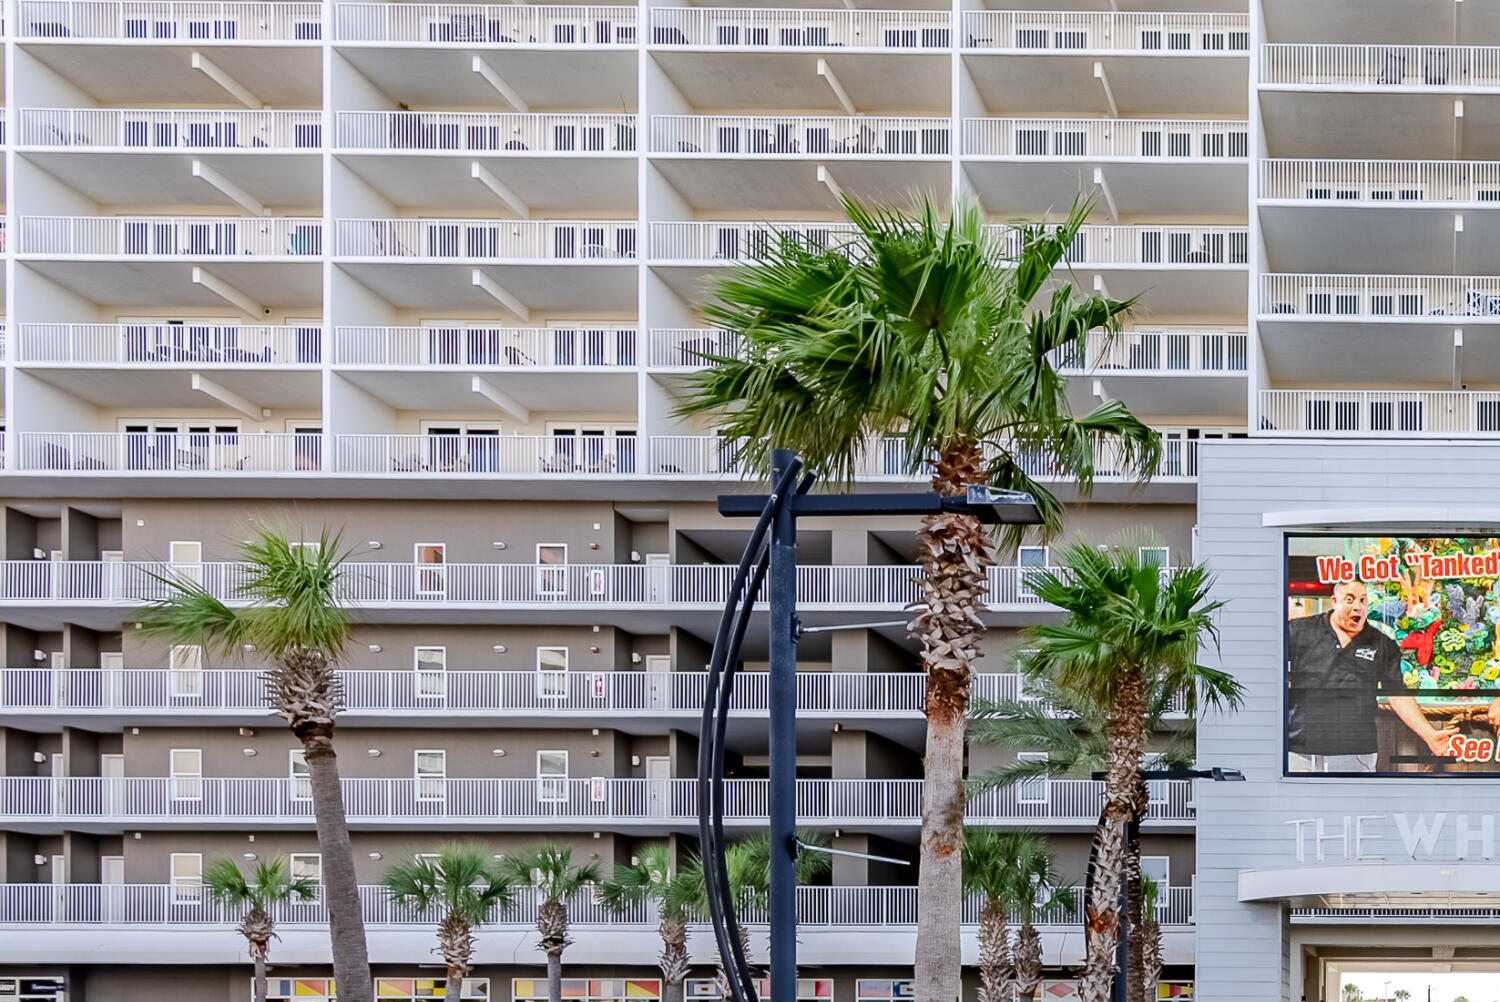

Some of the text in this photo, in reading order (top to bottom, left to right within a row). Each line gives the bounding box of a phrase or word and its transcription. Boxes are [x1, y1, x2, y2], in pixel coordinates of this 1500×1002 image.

[1316, 556, 1354, 582] We
[1360, 555, 1400, 581] Got
[1449, 735, 1491, 761] See
[1284, 815, 1387, 864] THE
